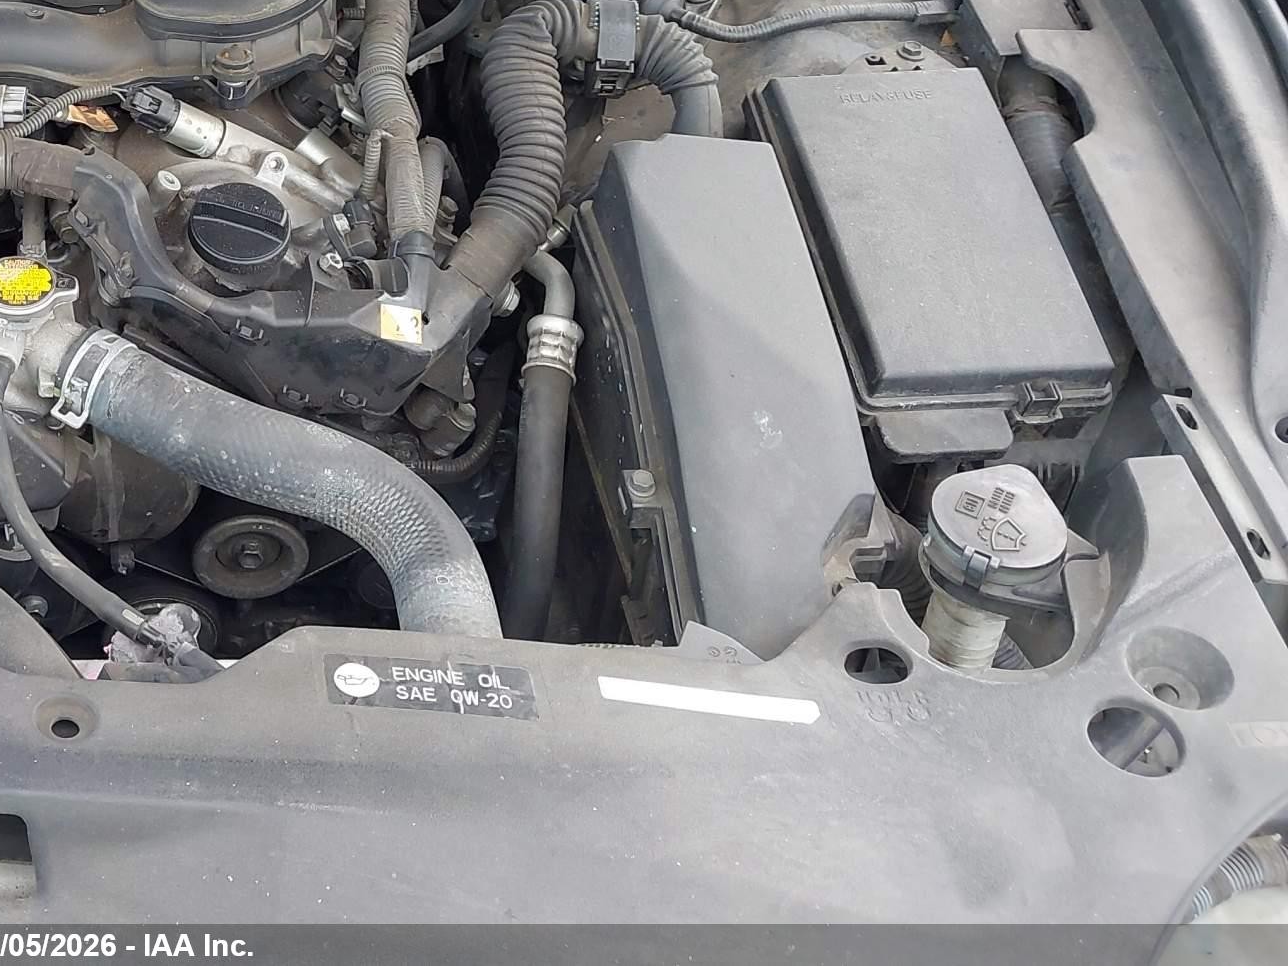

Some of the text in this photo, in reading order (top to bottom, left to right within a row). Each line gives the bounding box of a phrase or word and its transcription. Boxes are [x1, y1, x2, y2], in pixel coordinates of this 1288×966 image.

[391, 666, 511, 691] ENGINE OIL
[395, 685, 513, 709] SAE 0W-20
